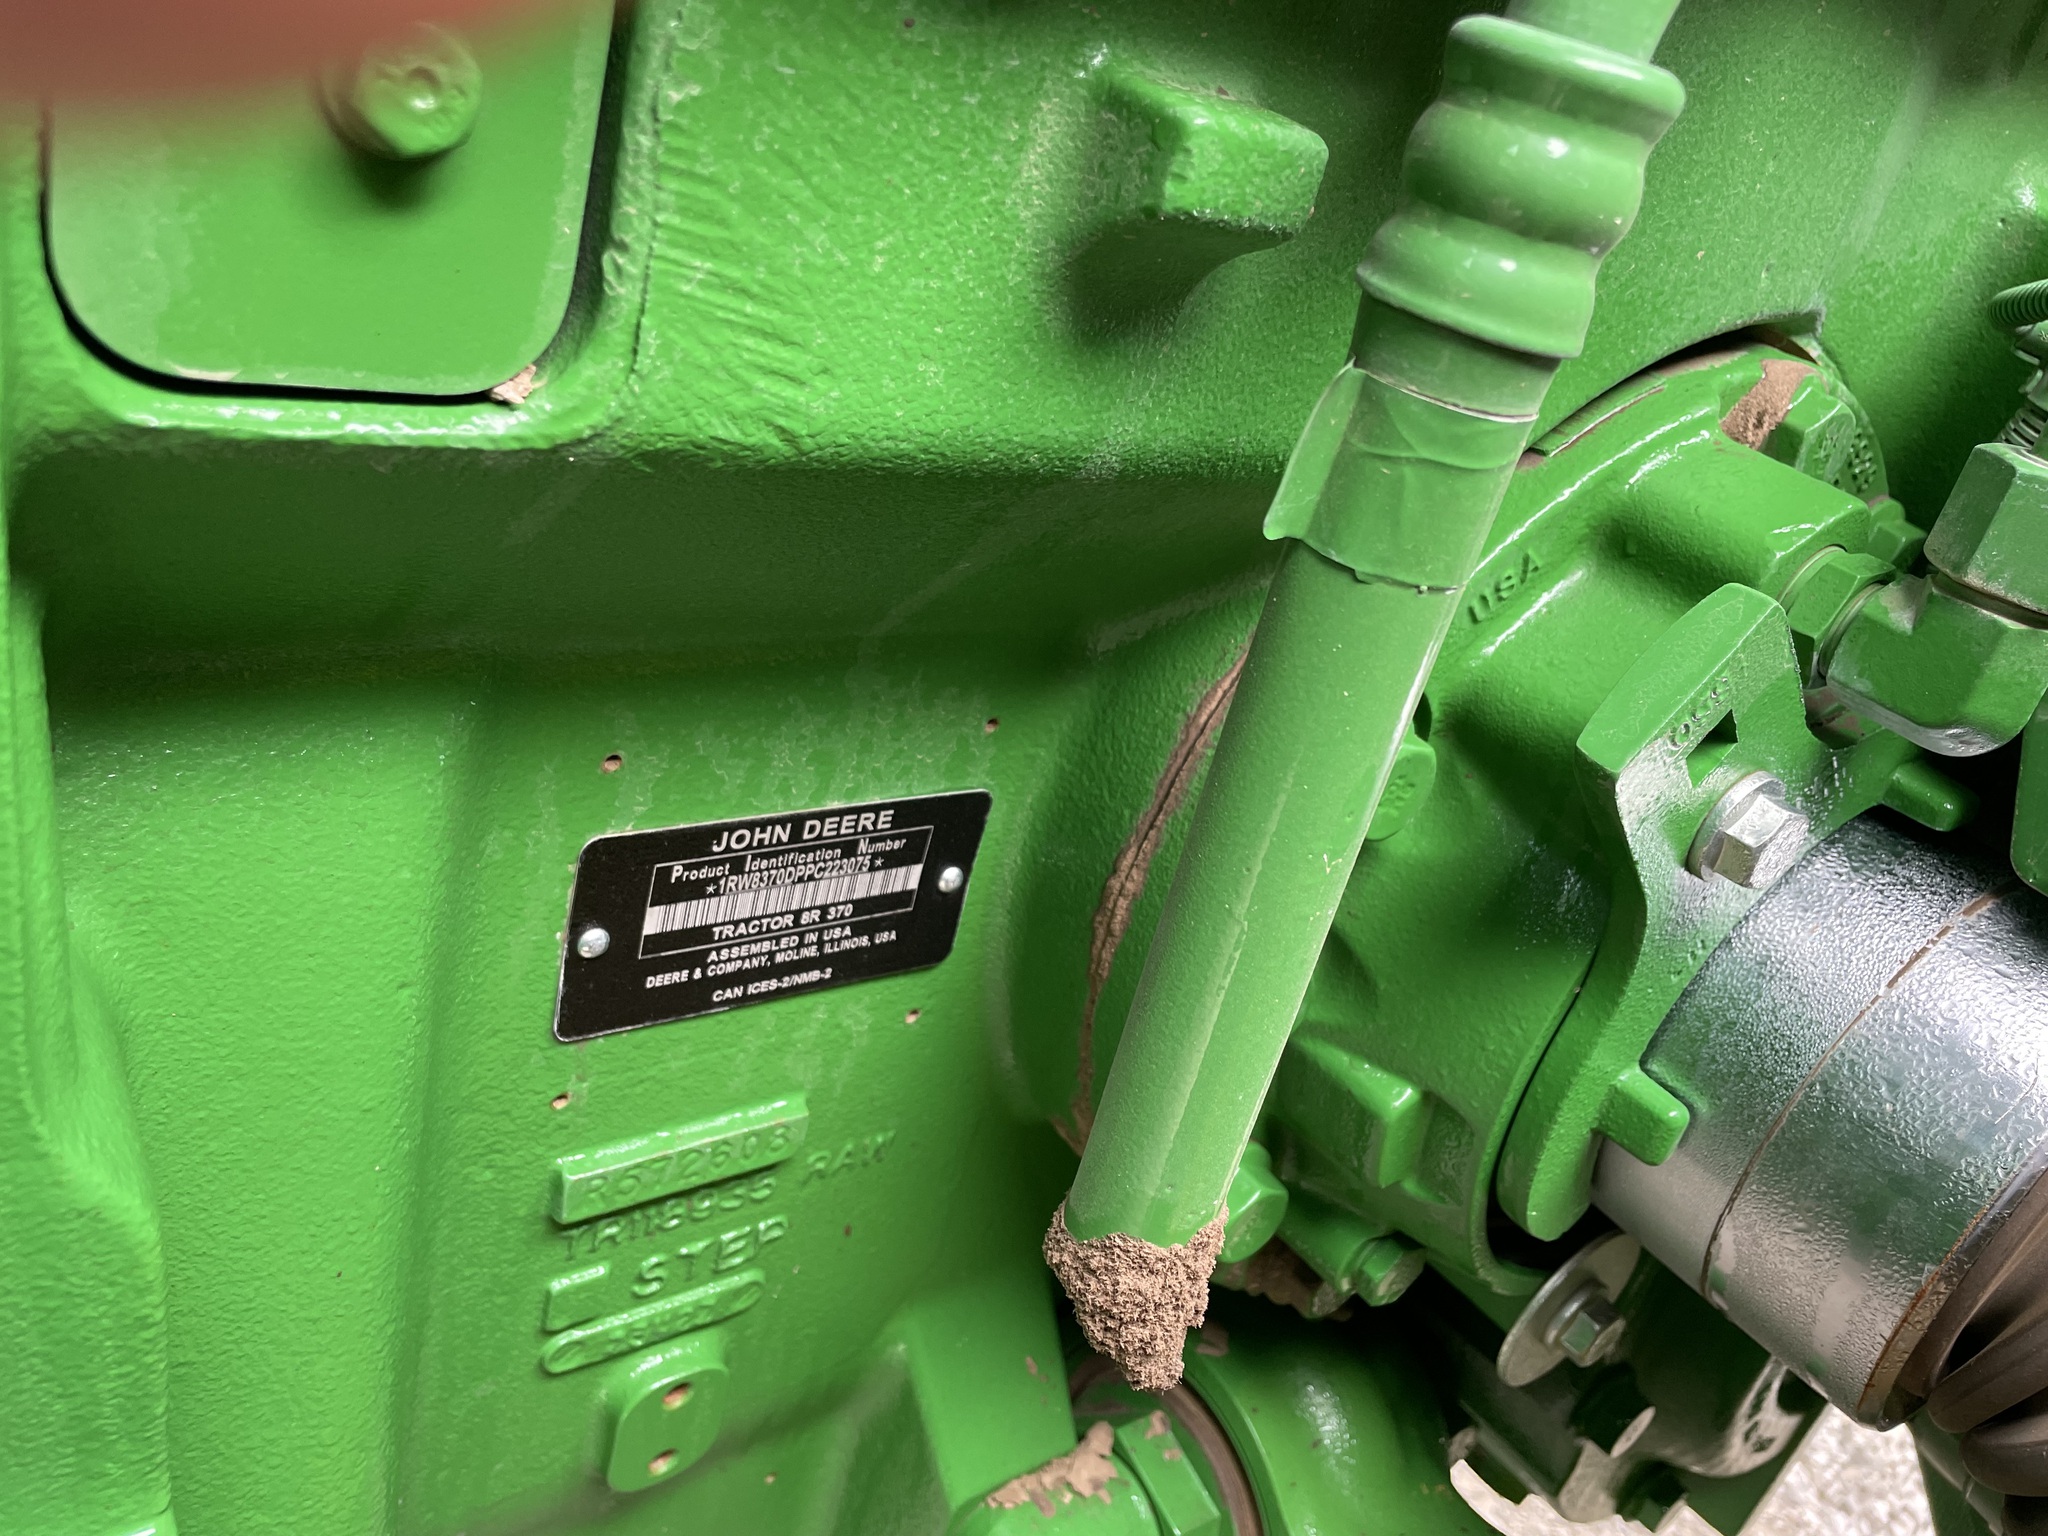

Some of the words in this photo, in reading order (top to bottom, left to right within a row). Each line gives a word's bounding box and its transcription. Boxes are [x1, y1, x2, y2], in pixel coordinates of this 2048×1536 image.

[1468, 552, 1541, 623] USA
[713, 822, 793, 852] JOHN
[802, 810, 895, 840] DEERE
[671, 862, 730, 883] Product
[745, 846, 841, 872] Identification
[858, 837, 907, 855] Number
[707, 935, 798, 963] ASSEMBLED
[804, 931, 818, 945] IN
[824, 926, 852, 941] USA
[712, 915, 793, 941] TRACTOR
[800, 911, 821, 925] 8R
[828, 904, 853, 920] 370
[646, 970, 689, 989] DEERE
[693, 968, 703, 979] &
[707, 956, 771, 977] COMPANY,
[775, 945, 820, 964] MOLINE,
[824, 938, 871, 955] ILLINOIS,
[874, 930, 897, 944] USA
[712, 986, 742, 1002] CAN
[747, 968, 832, 995] ICES-2/NMB-2
[631, 1214, 789, 1298] STEP
